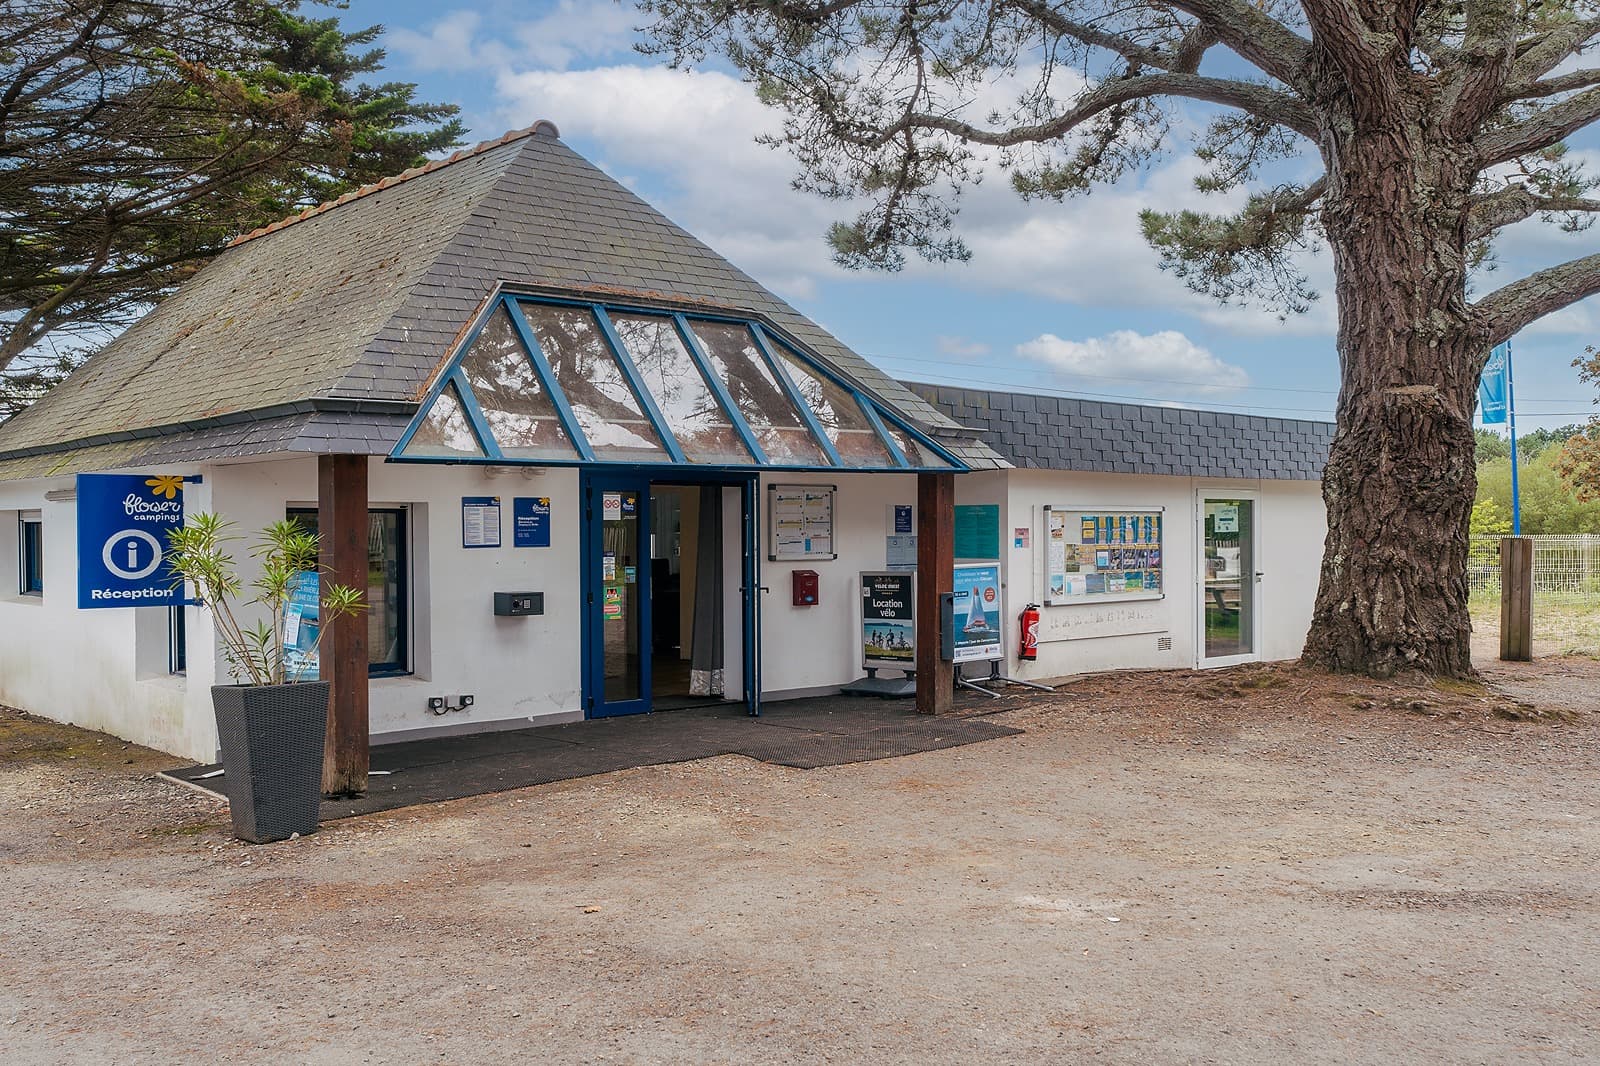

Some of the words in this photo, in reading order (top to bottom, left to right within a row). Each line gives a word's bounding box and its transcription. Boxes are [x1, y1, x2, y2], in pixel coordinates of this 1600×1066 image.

[122, 493, 181, 515] flower
[134, 512, 181, 523] campings
[91, 587, 174, 600] Réception
[872, 598, 903, 608] Location
[880, 608, 896, 617] vélo
